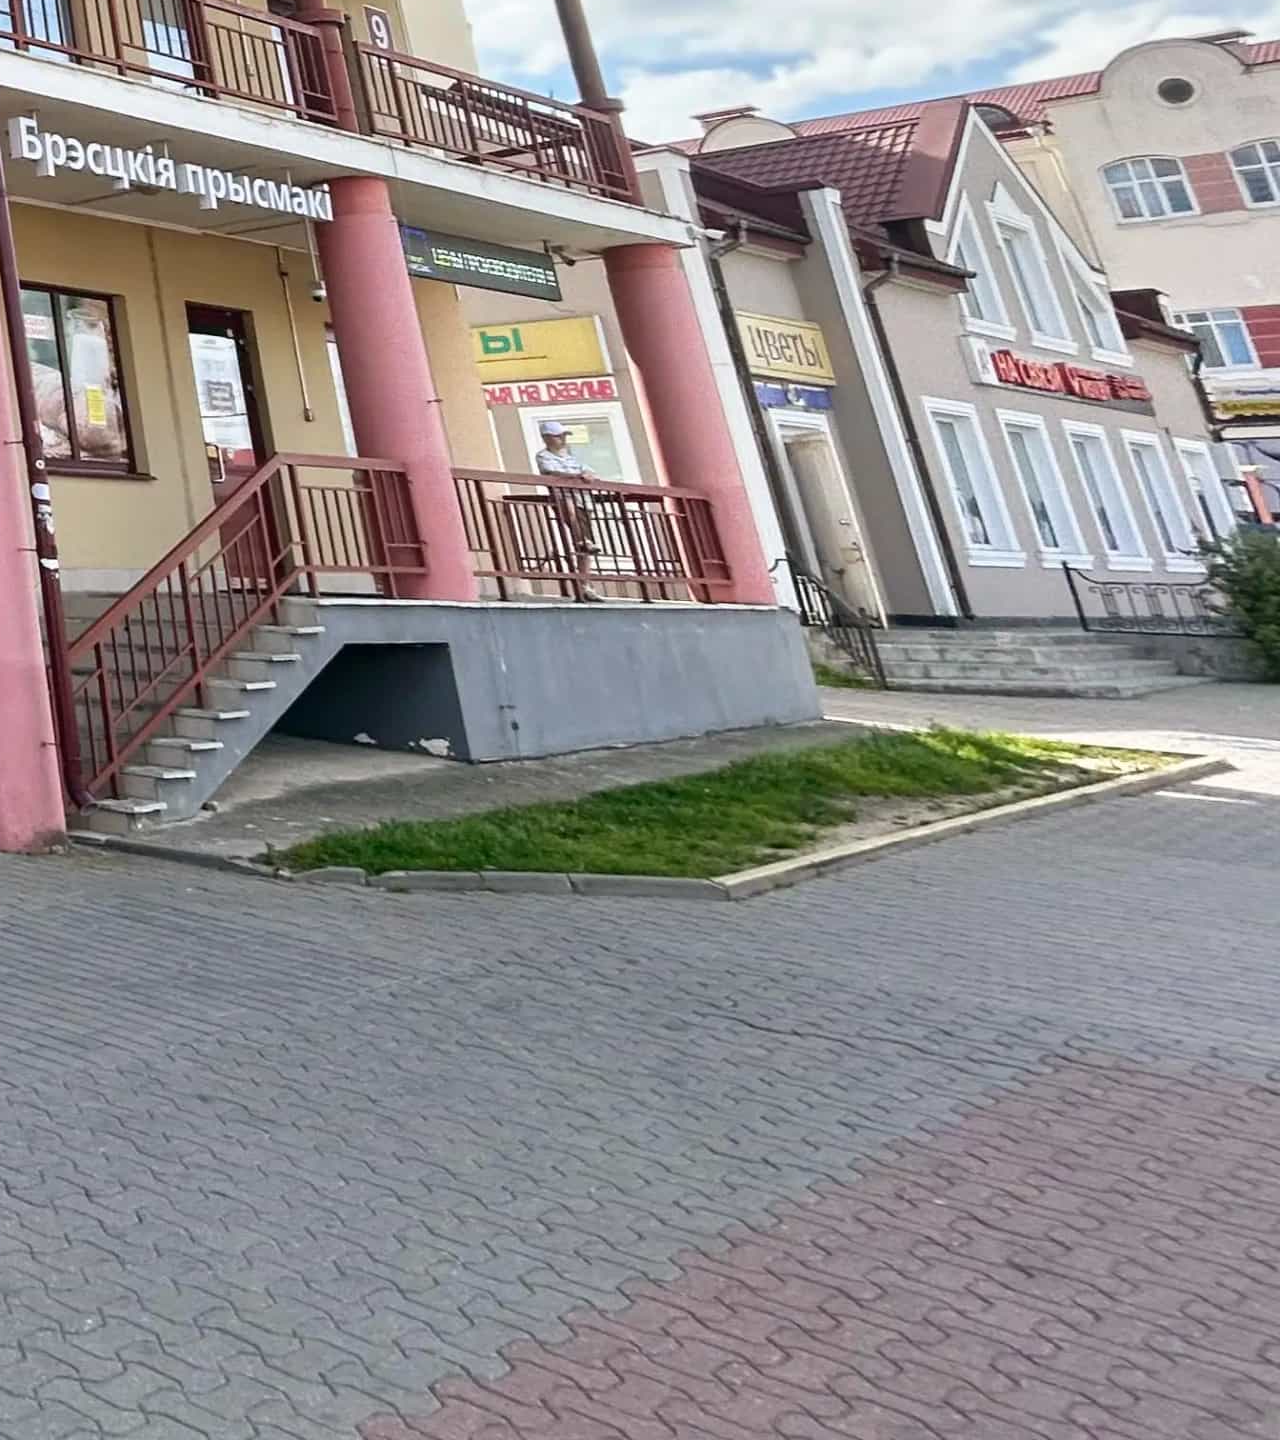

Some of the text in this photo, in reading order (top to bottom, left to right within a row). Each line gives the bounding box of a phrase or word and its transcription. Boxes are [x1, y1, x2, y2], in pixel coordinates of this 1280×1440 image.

[371, 14, 389, 50] 9
[7, 116, 334, 222] Брэсцкія прысмакі
